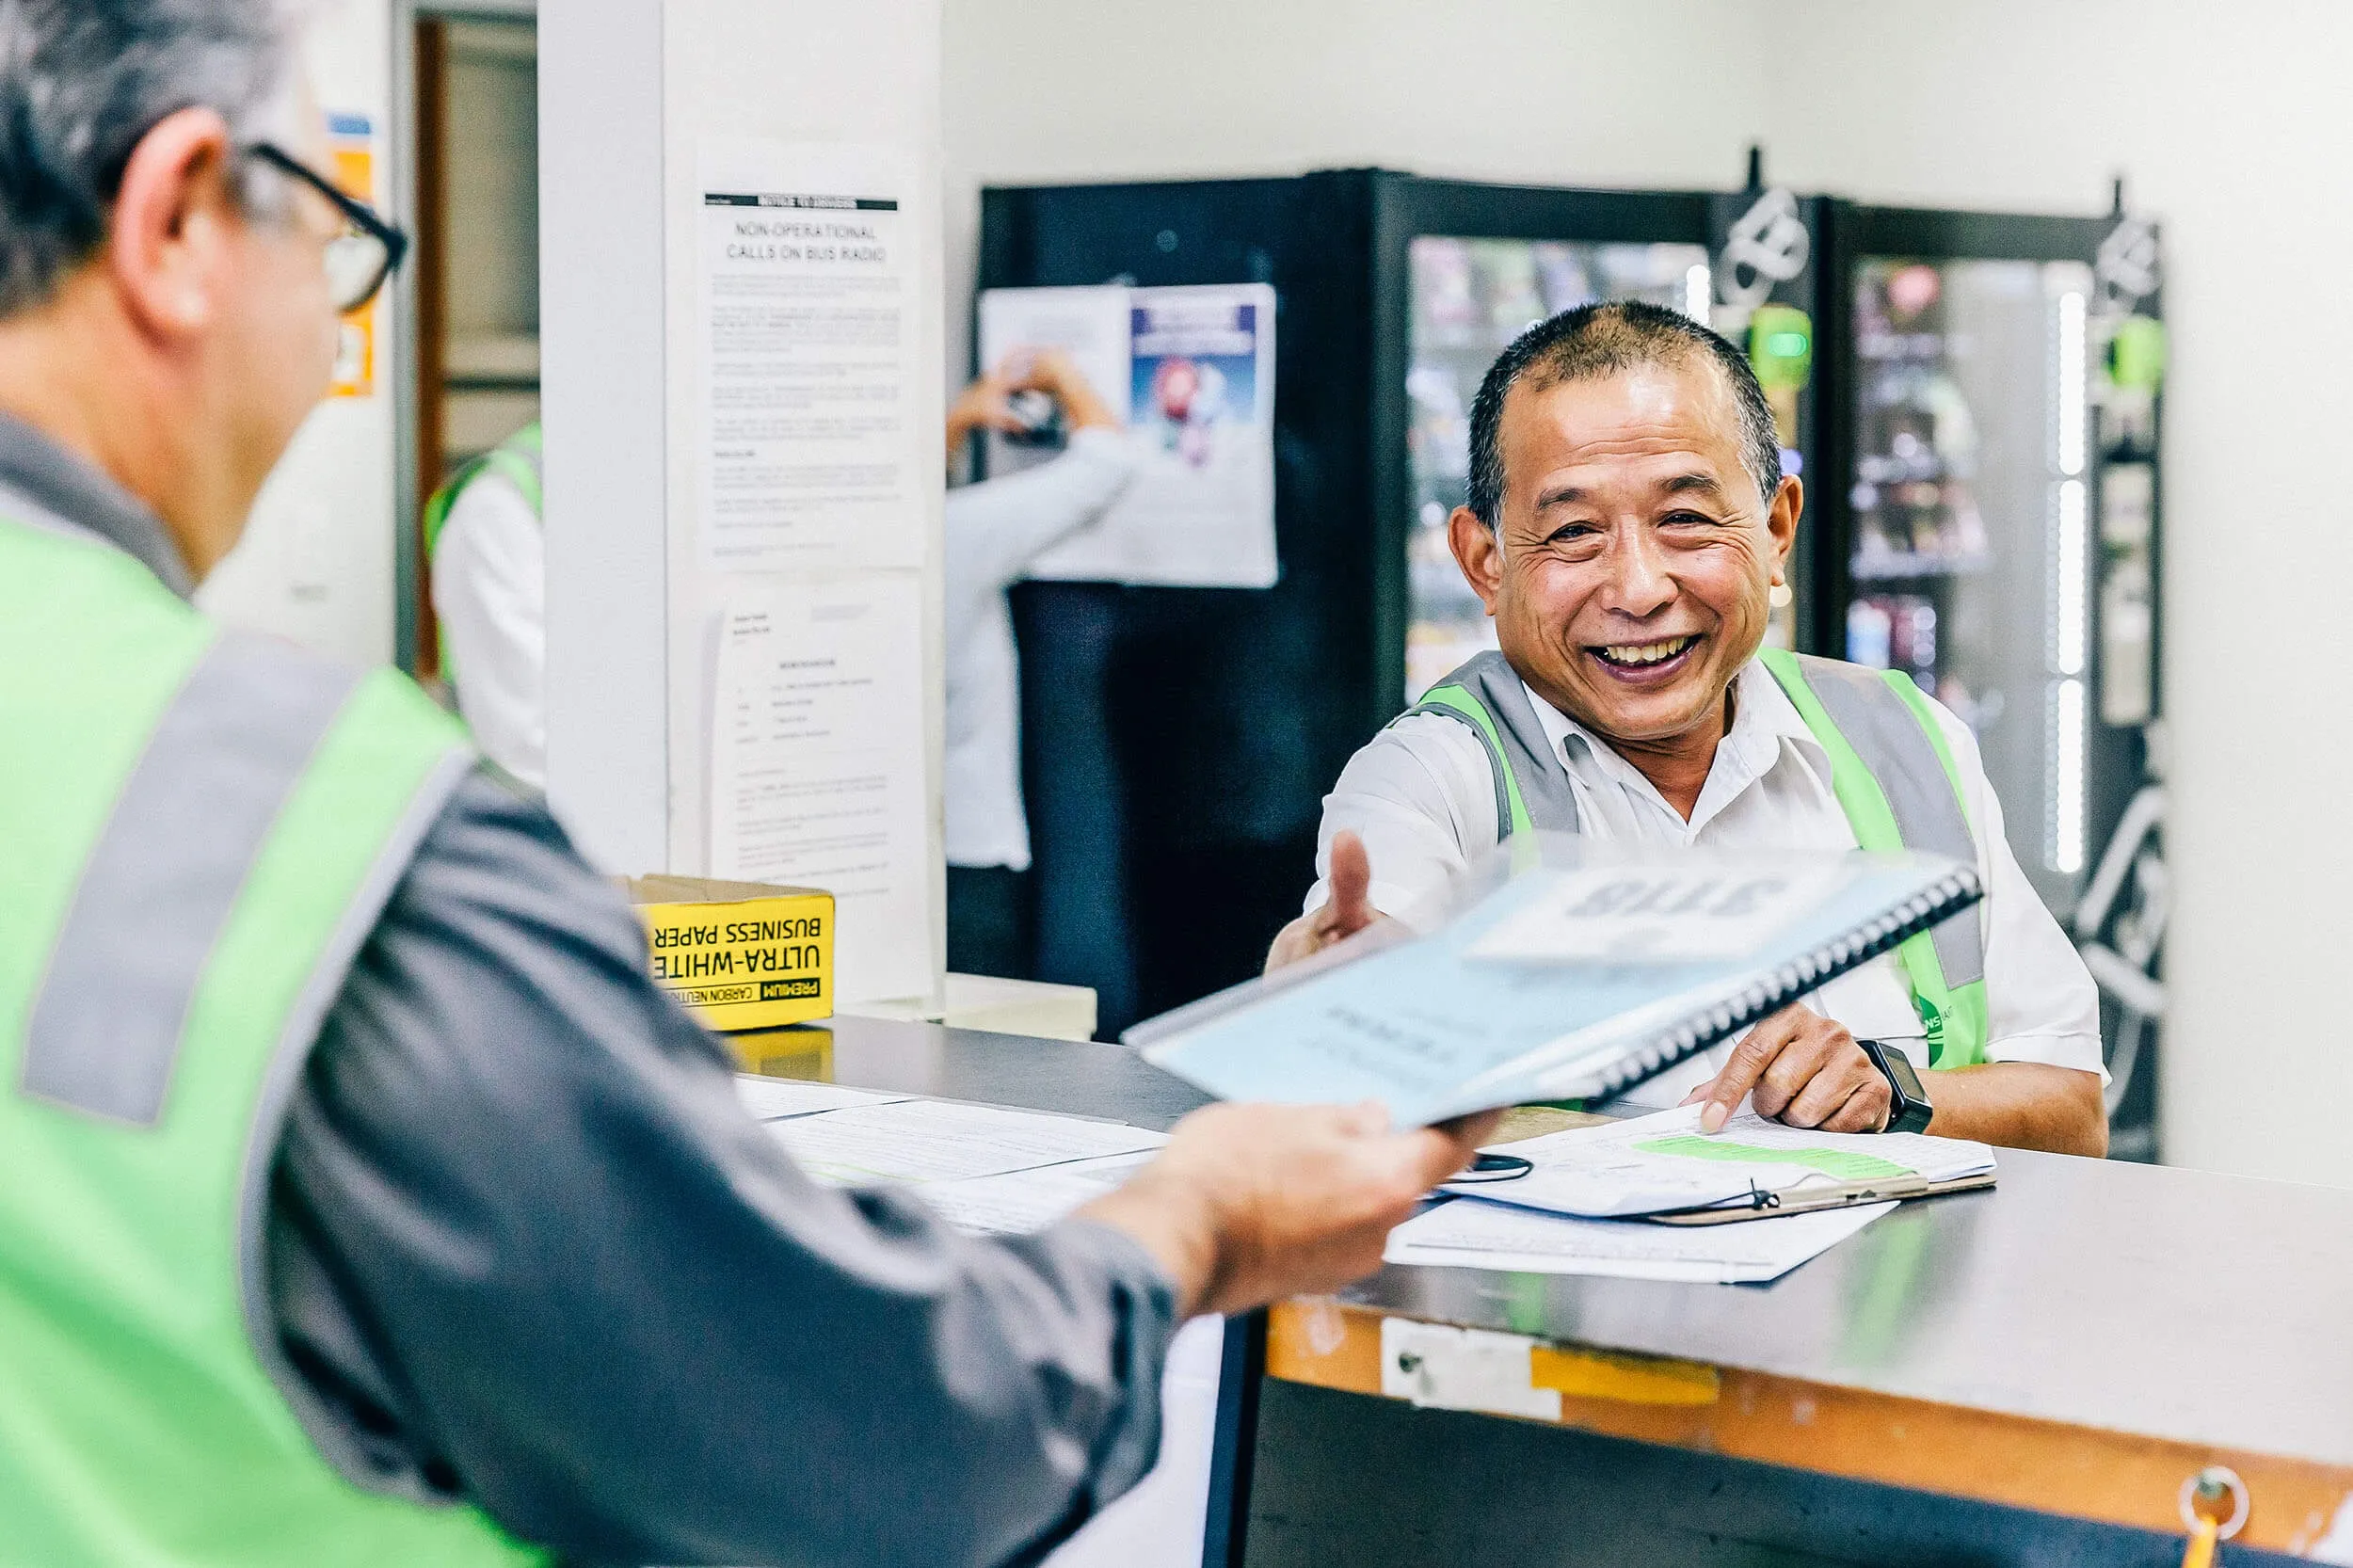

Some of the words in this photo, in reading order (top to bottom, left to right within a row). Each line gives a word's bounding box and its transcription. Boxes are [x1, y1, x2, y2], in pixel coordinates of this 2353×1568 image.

[735, 221, 877, 239] NON-OPERATIONAL
[727, 243, 776, 259] CALLS
[779, 245, 801, 259] ON
[806, 245, 836, 261] BUS
[840, 246, 887, 263] RADIO
[655, 924, 718, 948] PAPER
[726, 918, 821, 942] BUSINESS
[654, 945, 821, 980] ULTRA-WHITE
[710, 987, 753, 1003] CARBON
[762, 981, 818, 998] PREMIUM
